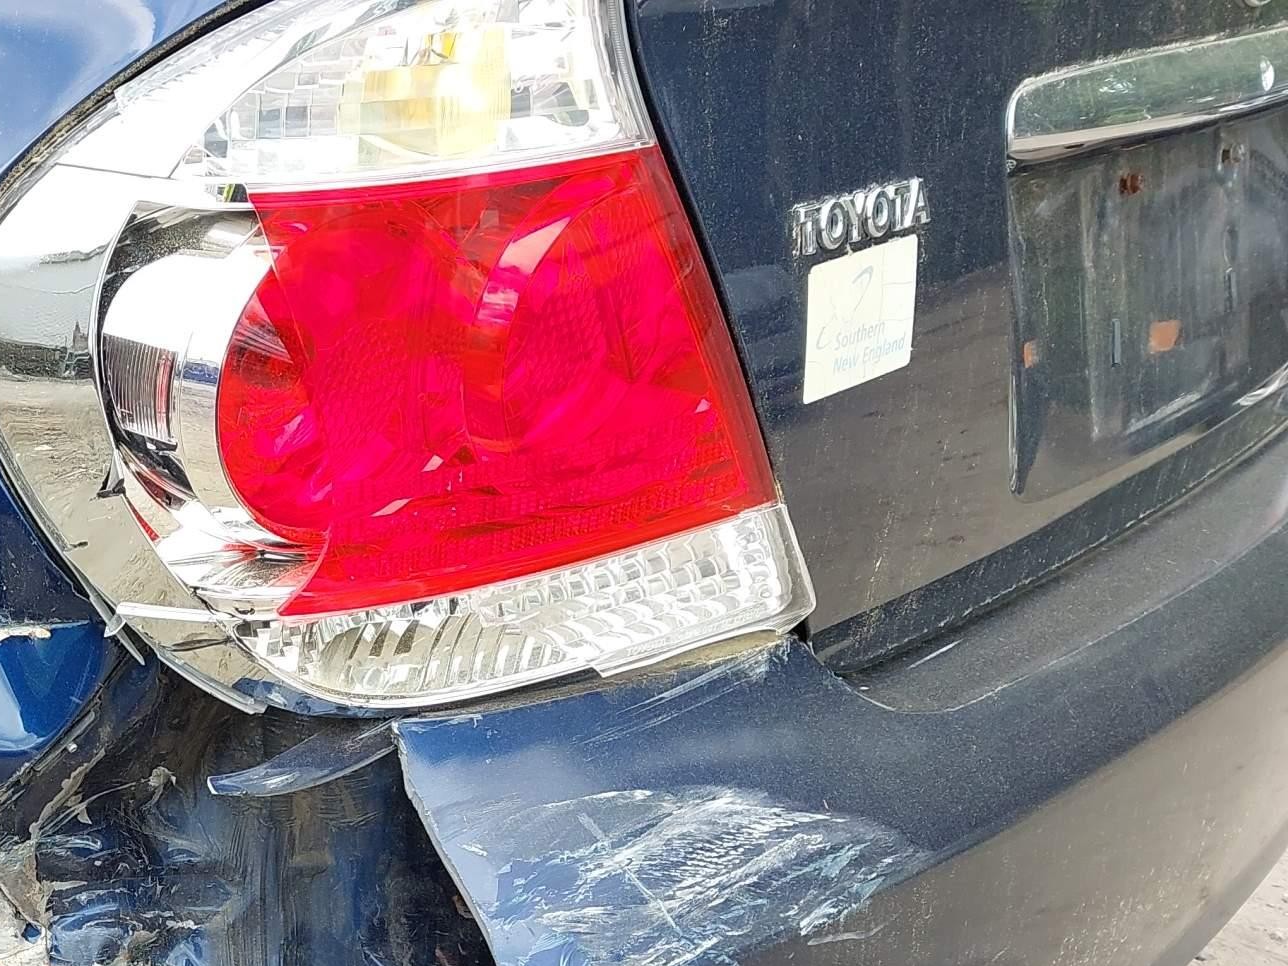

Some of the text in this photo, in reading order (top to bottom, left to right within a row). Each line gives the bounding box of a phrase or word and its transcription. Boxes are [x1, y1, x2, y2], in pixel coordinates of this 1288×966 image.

[790, 177, 931, 256] TOYOTA
[832, 333, 906, 376] New England
[834, 322, 885, 351] Southern
